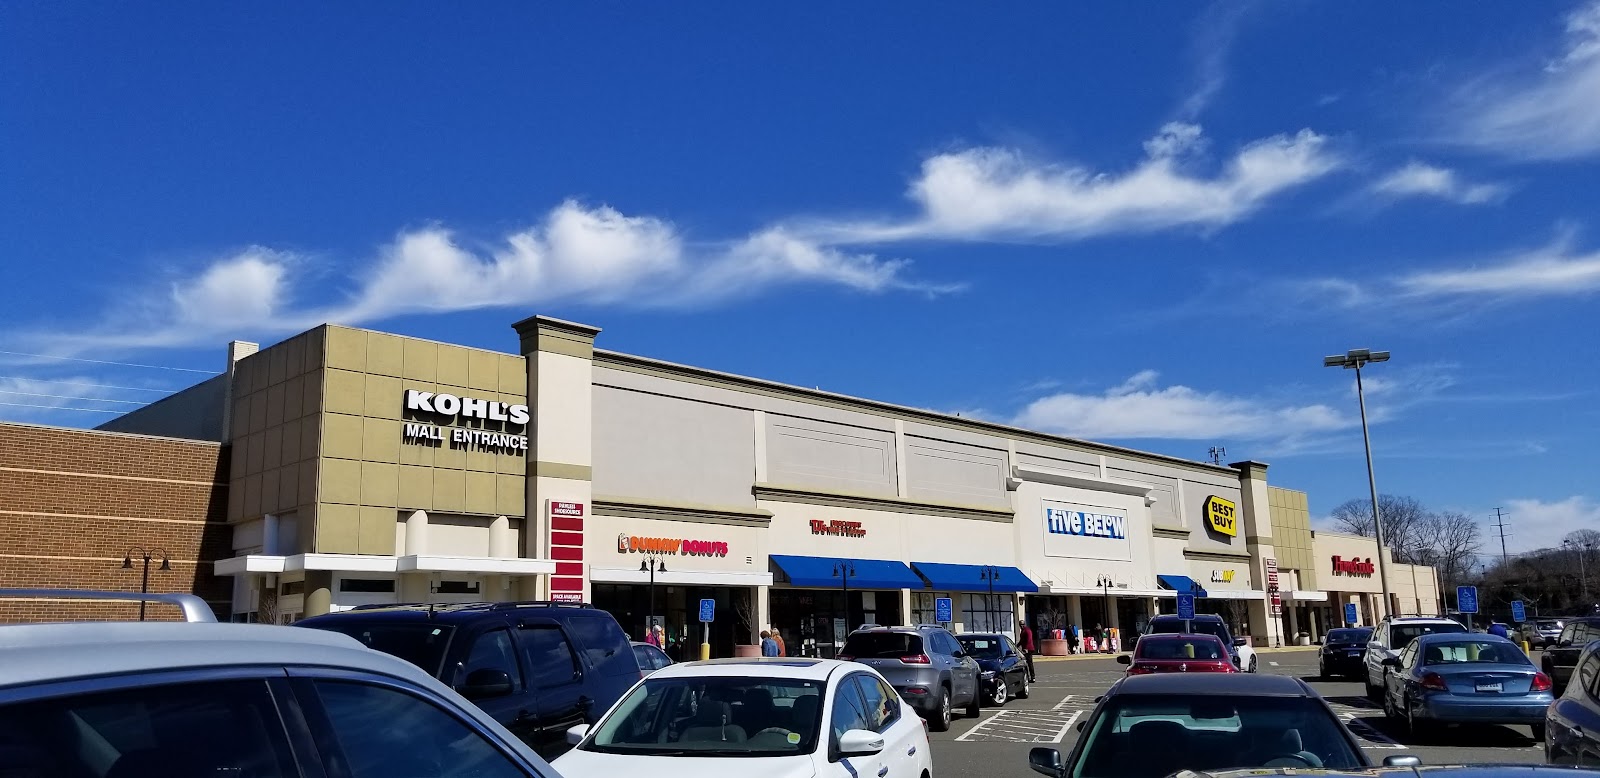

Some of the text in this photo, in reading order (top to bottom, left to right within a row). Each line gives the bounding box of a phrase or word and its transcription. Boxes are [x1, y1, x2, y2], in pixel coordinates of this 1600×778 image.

[406, 389, 530, 425] KOHL'S
[405, 423, 529, 450] MALL ENTRANCE
[1211, 501, 1234, 518] BEST
[1213, 514, 1233, 530] BUY
[681, 539, 729, 556] DONUTS
